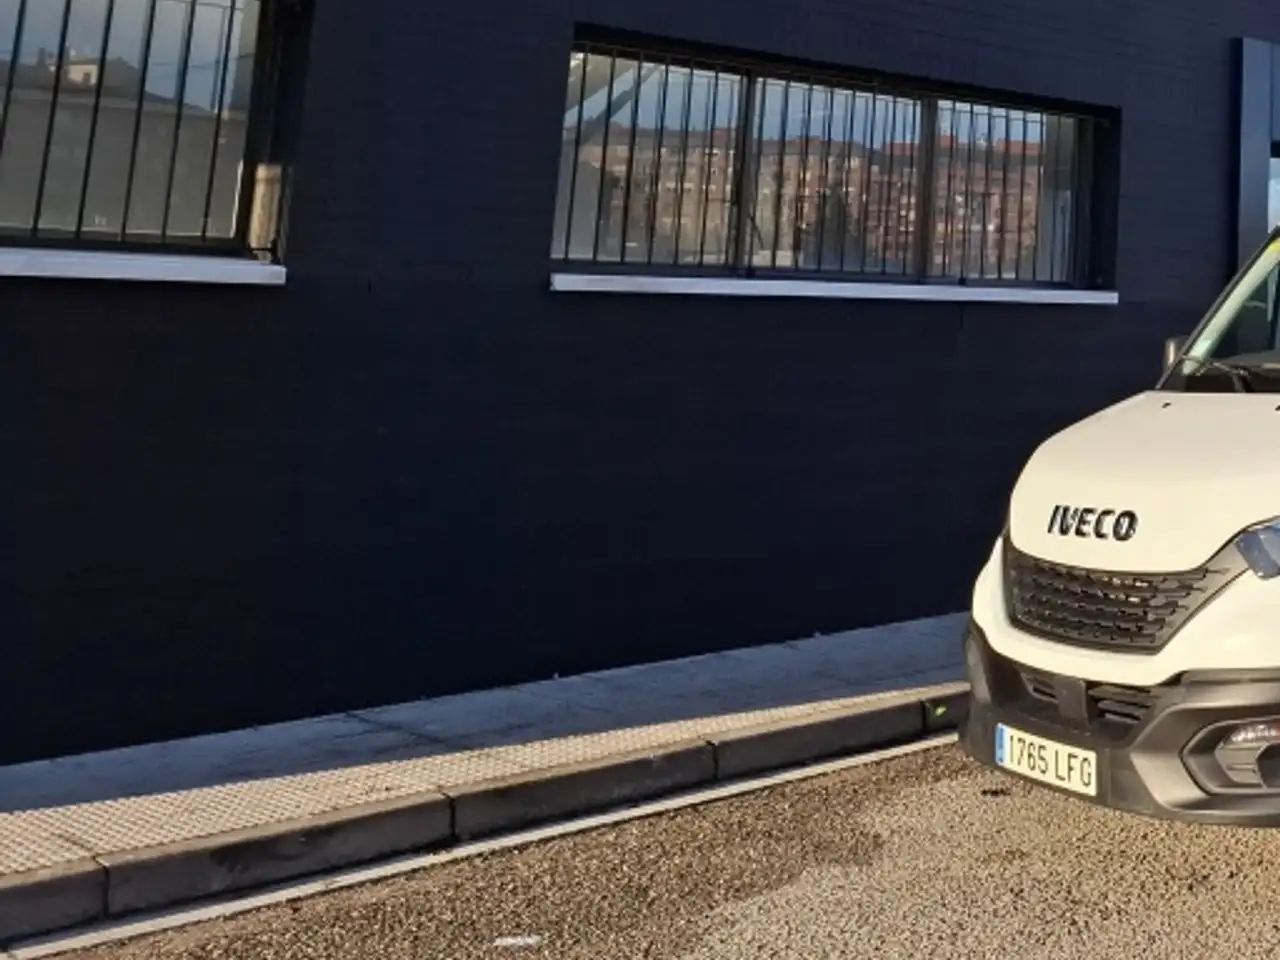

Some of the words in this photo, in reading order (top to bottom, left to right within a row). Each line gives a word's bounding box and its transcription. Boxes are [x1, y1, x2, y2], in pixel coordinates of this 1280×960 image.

[1047, 504, 1139, 542] IVECO
[1009, 734, 1049, 775] 1765
[1055, 750, 1092, 788] LFG
